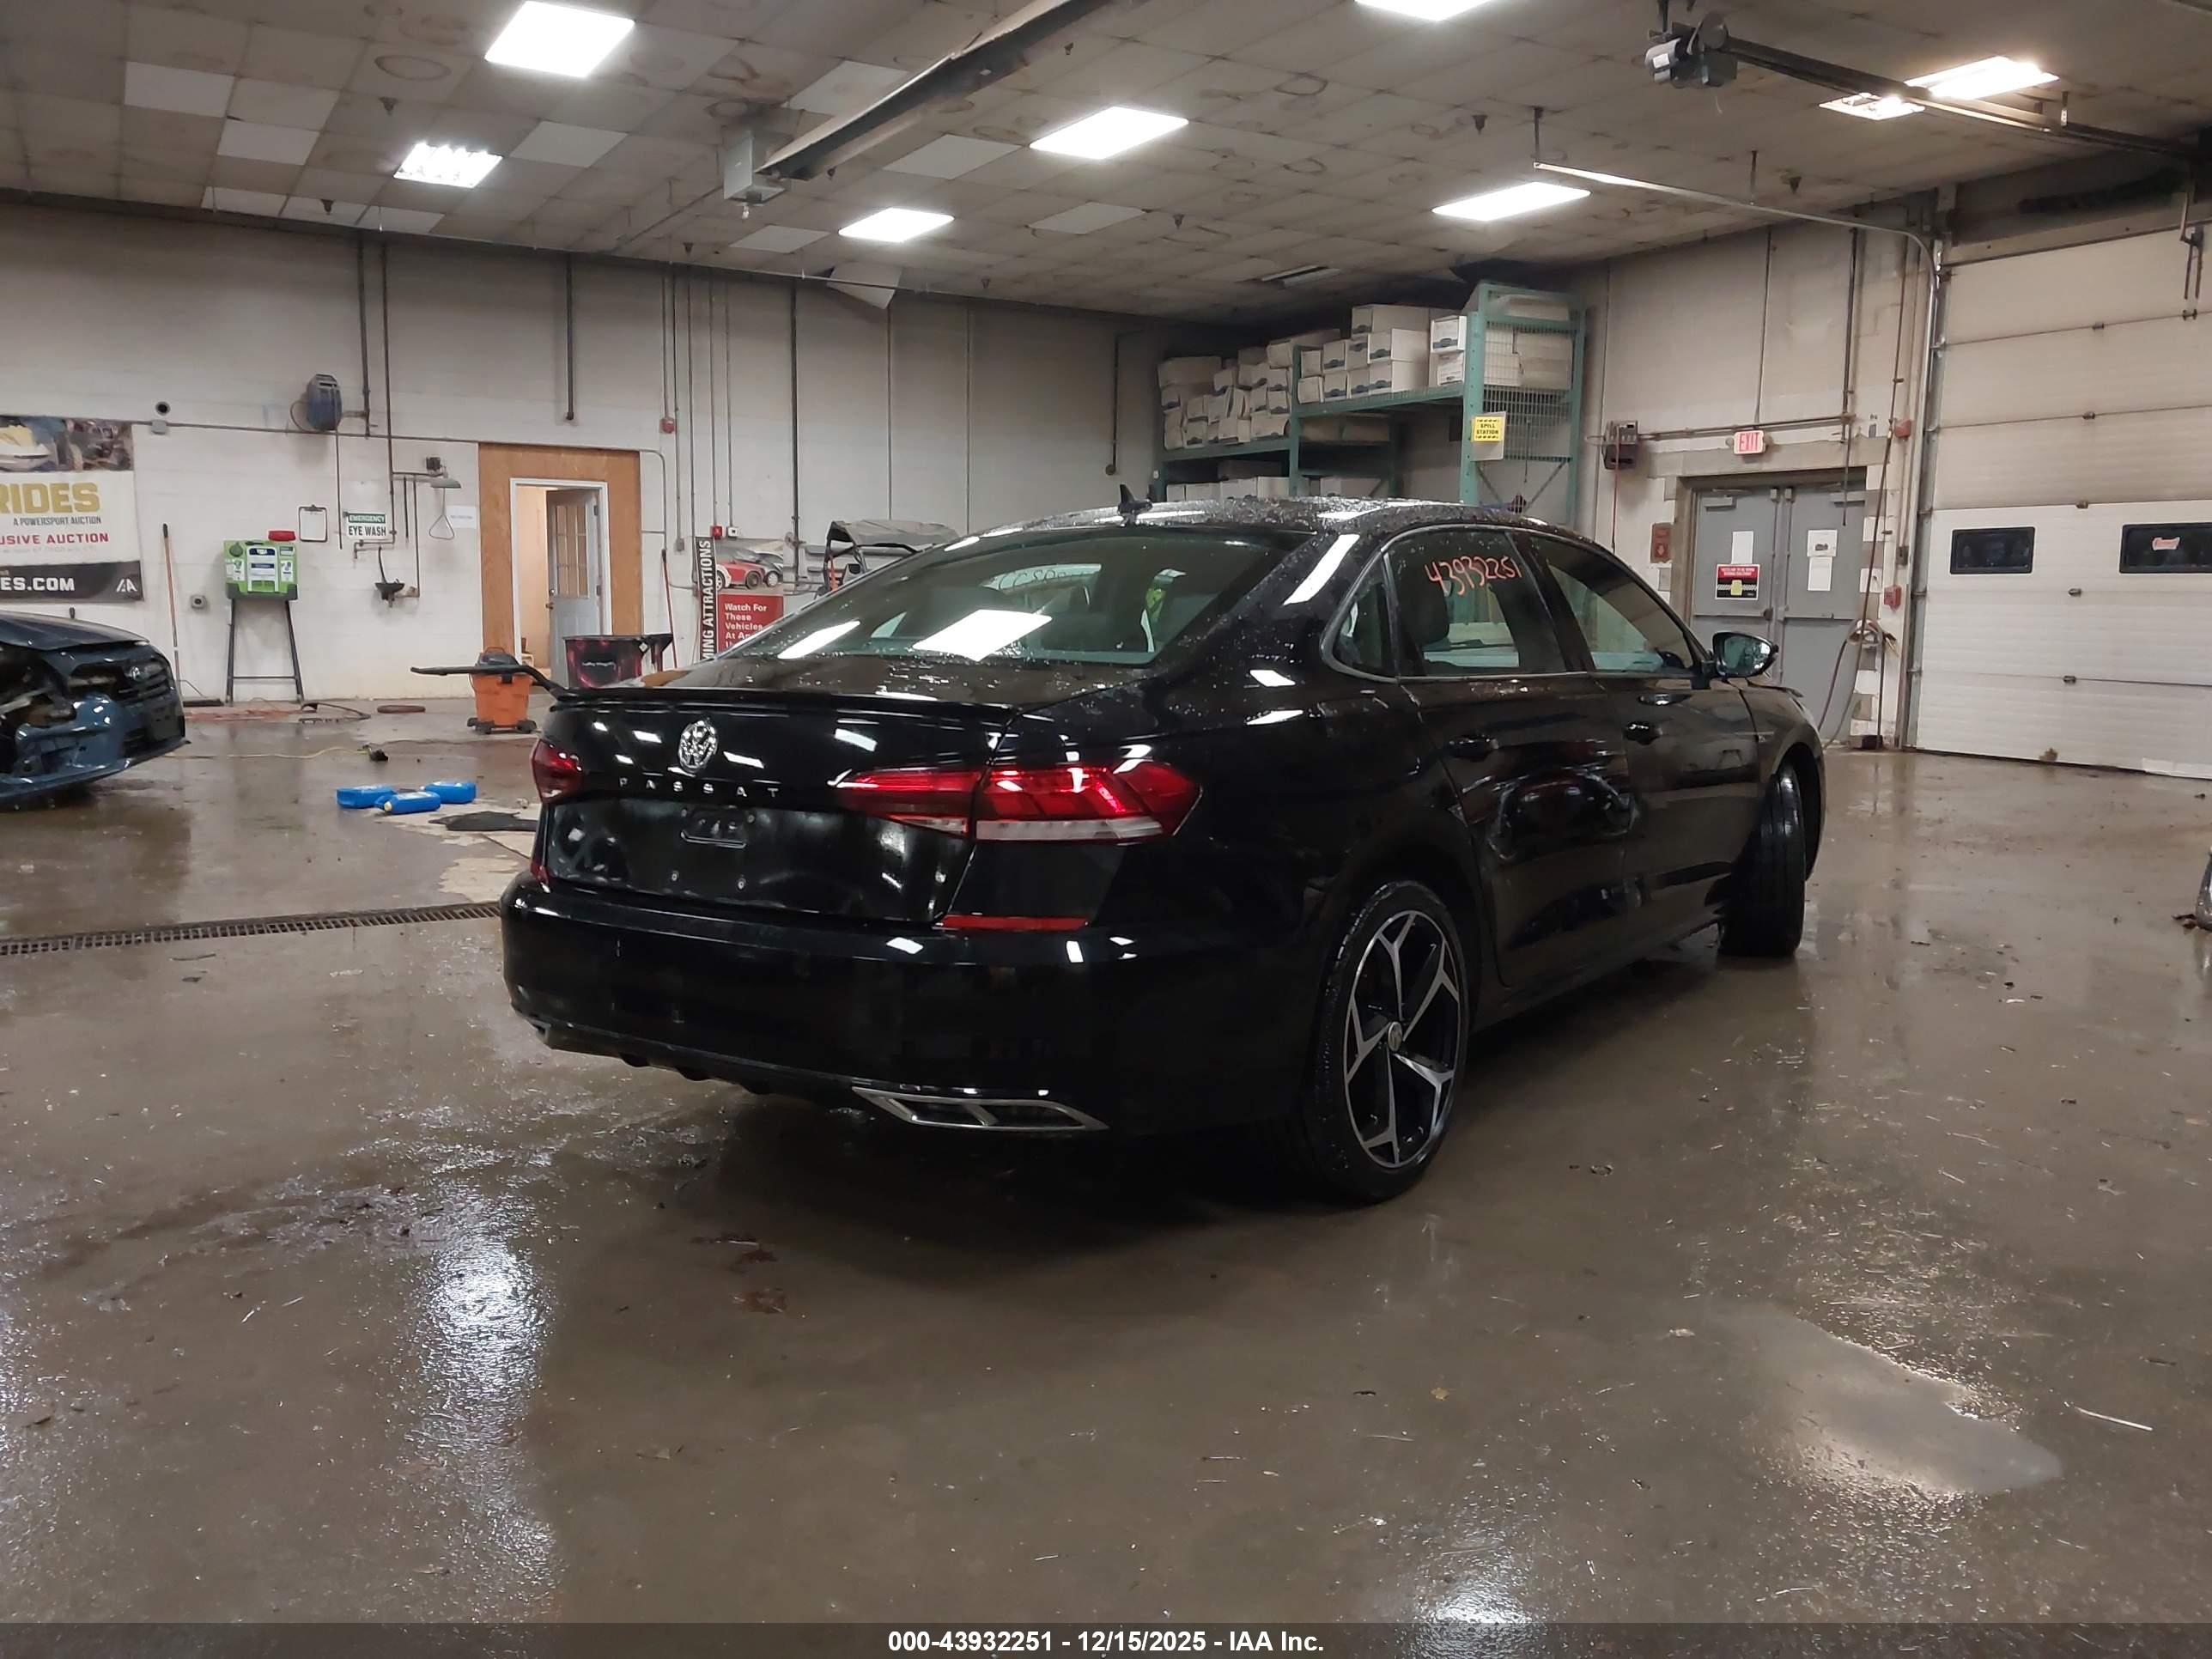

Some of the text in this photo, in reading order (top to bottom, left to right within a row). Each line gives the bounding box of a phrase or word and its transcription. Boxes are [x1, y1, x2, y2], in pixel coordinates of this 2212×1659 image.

[1739, 432, 1759, 453] EXIT
[13, 516, 101, 526] A POWERSPORT AUCTION
[349, 526, 386, 536] EYE WASH
[46, 533, 109, 544] AUCTION
[1425, 556, 1522, 596] 43932251
[0, 577, 76, 592] ES.COM
[699, 540, 714, 628] ATTRACTIONS
[724, 603, 751, 611] Watch
[725, 612, 752, 621] These
[619, 777, 780, 798] PASSAT
